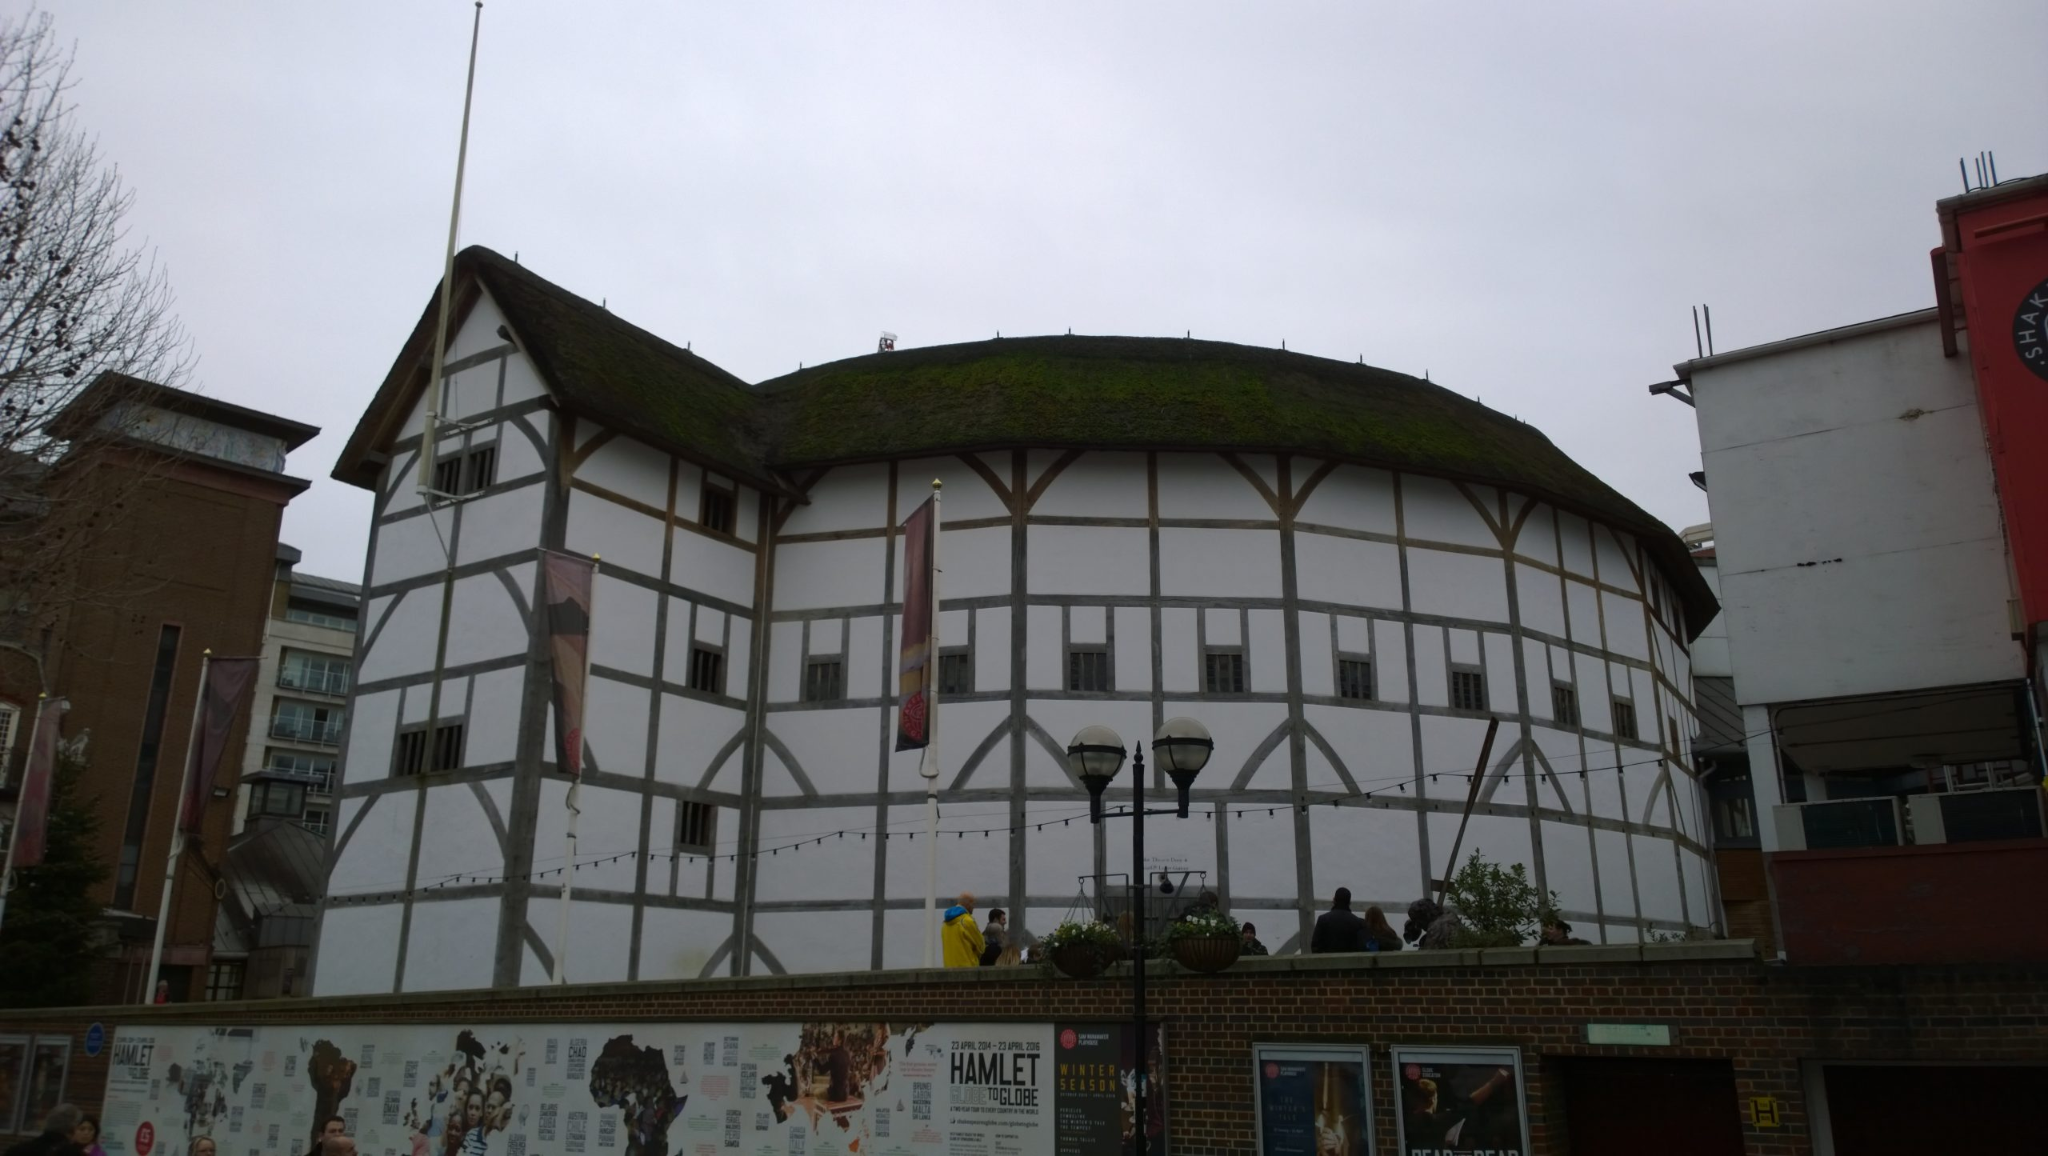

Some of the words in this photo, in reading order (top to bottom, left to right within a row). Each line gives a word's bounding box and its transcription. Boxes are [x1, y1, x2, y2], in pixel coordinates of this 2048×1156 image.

[113, 1044, 154, 1066] HAMLET
[952, 1041, 960, 1050] 23
[961, 1042, 977, 1050] APRIL
[978, 1042, 991, 1050] 2014
[998, 1042, 1007, 1051] 23
[1008, 1042, 1025, 1051] APRIL
[1026, 1042, 1040, 1051] 2016
[951, 1052, 1040, 1086] HAMLET
[1060, 1063, 1115, 1076] WINTER
[1060, 1078, 1115, 1092] SEASON
[950, 1086, 987, 1105] GLOBE
[987, 1087, 999, 1101] TO
[1000, 1088, 1039, 1107] GLOBE
[1754, 1100, 1776, 1123] H
